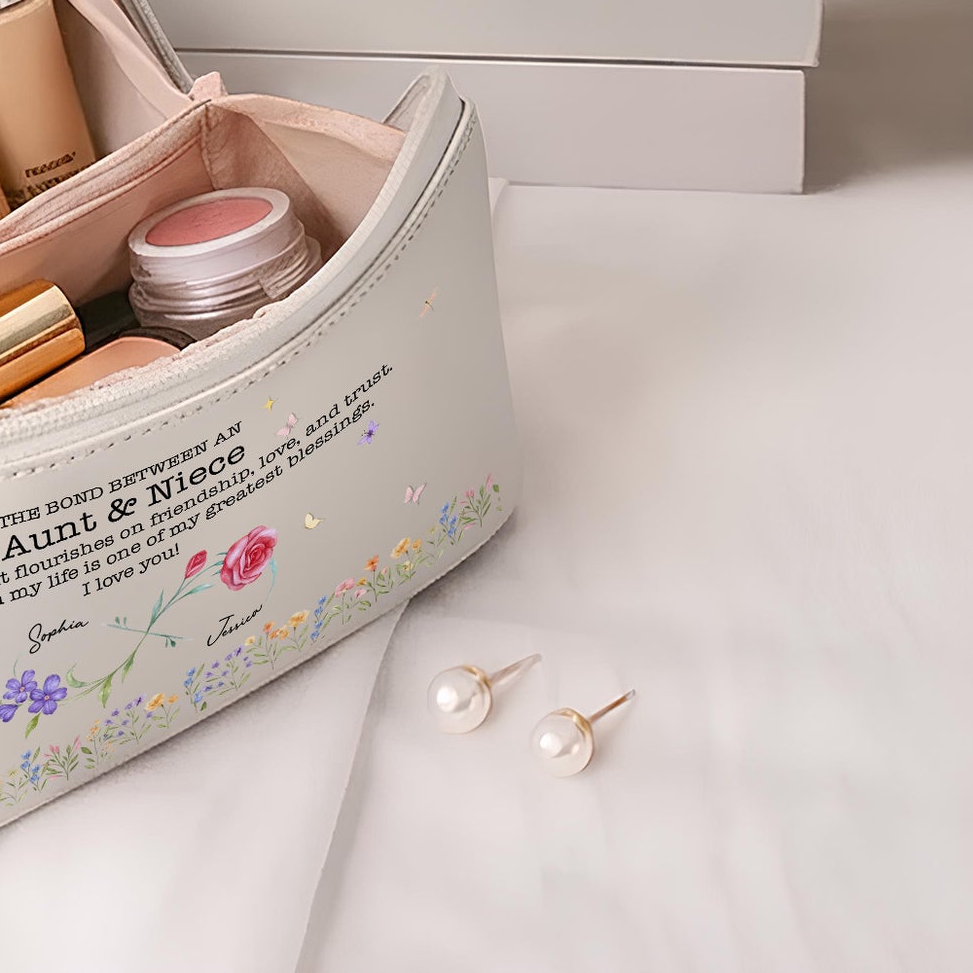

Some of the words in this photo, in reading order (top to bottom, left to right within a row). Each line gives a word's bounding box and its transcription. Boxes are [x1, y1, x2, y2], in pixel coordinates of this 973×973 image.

[1, 511, 98, 562] Aunt
[107, 497, 138, 524] &
[145, 445, 245, 508] Niece
[8, 581, 43, 603] my
[46, 568, 79, 590] life
[83, 559, 101, 575] is
[106, 542, 142, 566] one
[146, 527, 166, 547] of
[168, 512, 201, 538] my
[205, 465, 284, 521] greatest
[286, 399, 375, 469] blessings.
[14, 534, 115, 581] flourishes
[119, 522, 146, 540] on
[149, 468, 255, 528] friendship,
[258, 437, 301, 470] love,
[305, 403, 341, 437] and
[343, 364, 393, 407] trust.
[44, 486, 104, 516] BOND
[107, 439, 209, 494] BETWEEN
[213, 420, 243, 448] AN
[81, 581, 92, 597] I
[94, 566, 135, 592] love
[138, 542, 180, 575] you!
[28, 618, 90, 655] Sophia
[206, 603, 263, 647] Jessica
